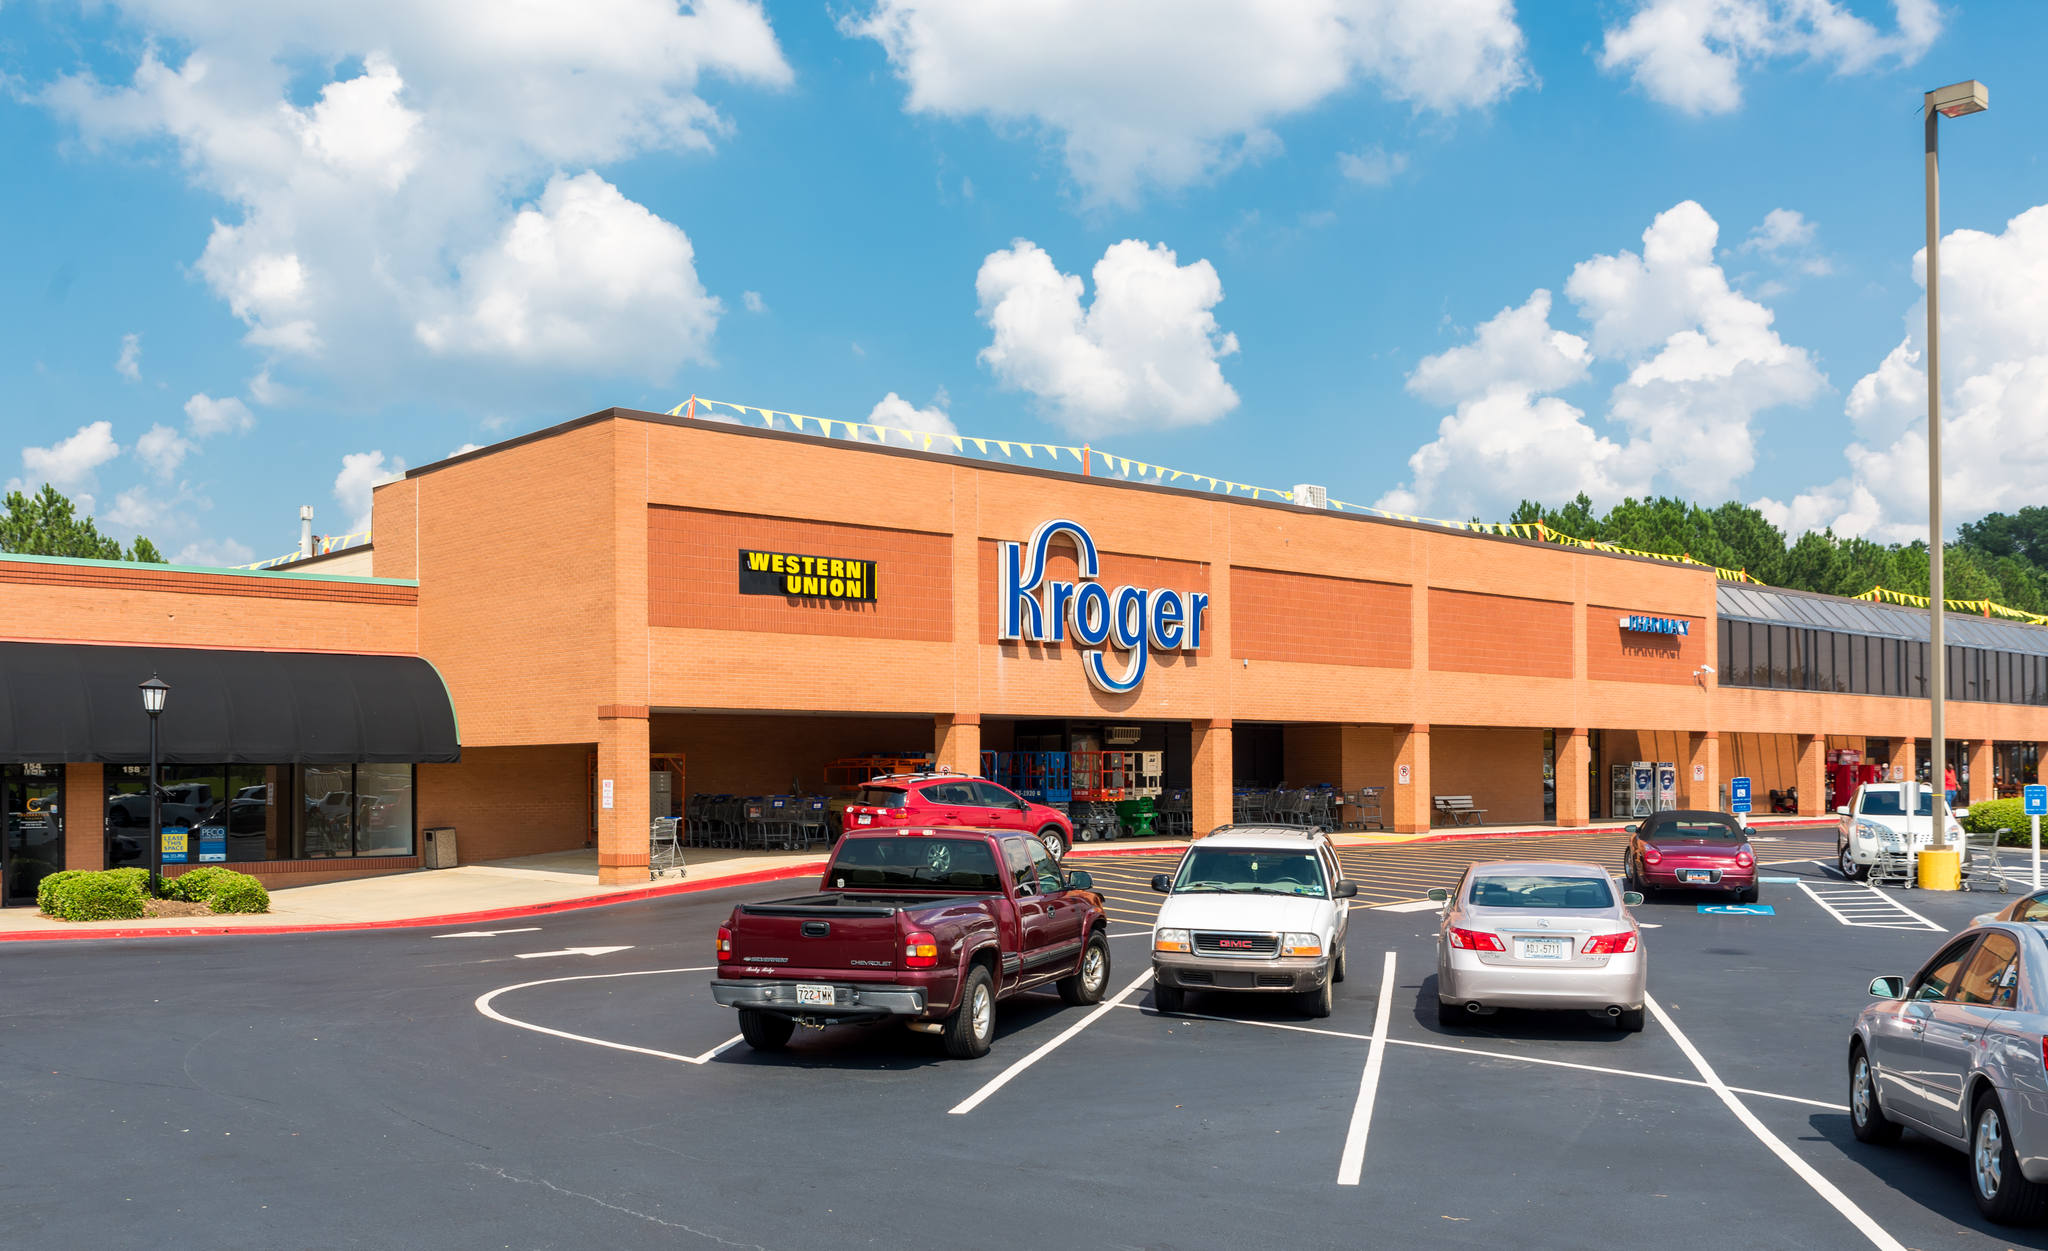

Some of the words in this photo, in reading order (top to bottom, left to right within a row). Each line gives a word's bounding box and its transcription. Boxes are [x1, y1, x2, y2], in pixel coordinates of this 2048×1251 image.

[748, 551, 862, 579] WESTERN
[786, 575, 862, 599] UNION
[998, 519, 1209, 694] Kroger
[1628, 615, 1689, 636] PHARMAY
[122, 765, 141, 774] 158
[1219, 939, 1252, 949] GMC
[850, 959, 893, 967] CHEVROLET
[798, 989, 815, 1001] 722
